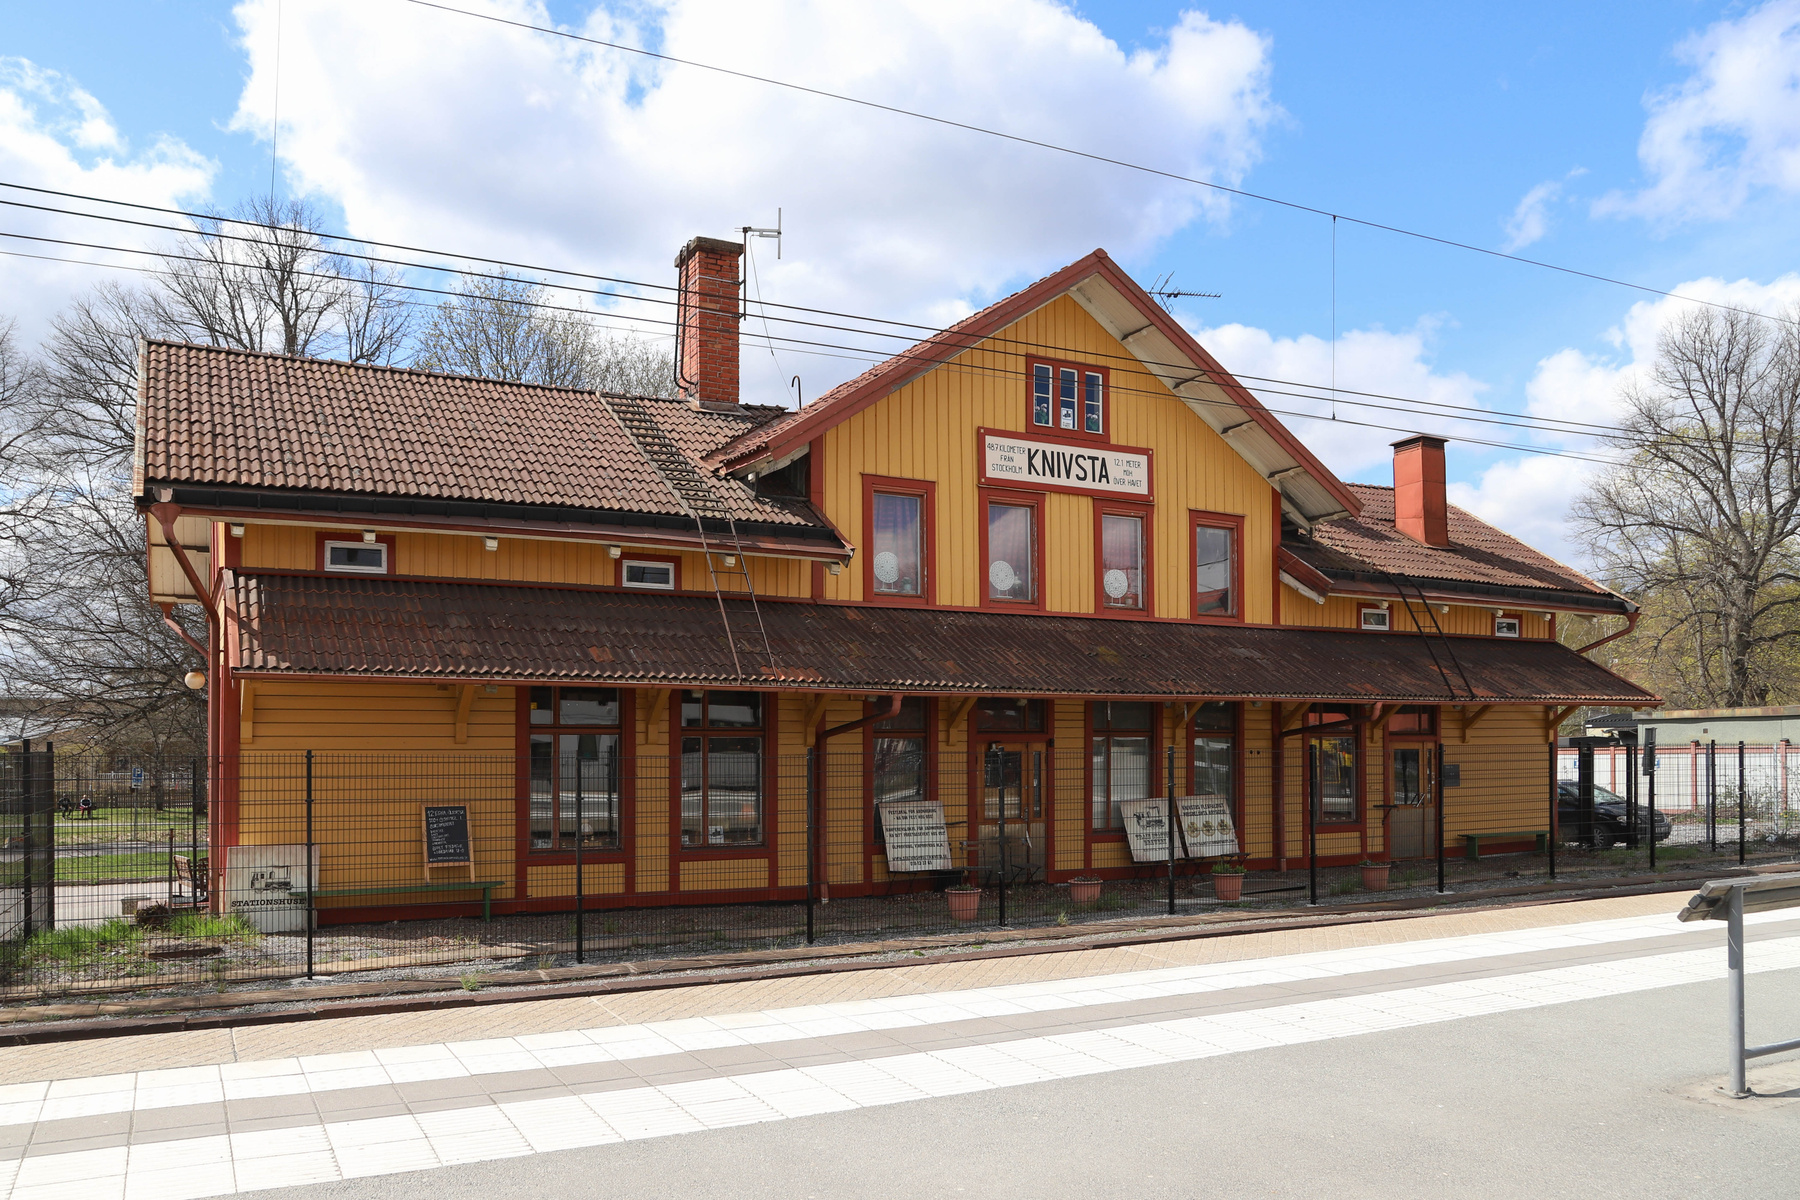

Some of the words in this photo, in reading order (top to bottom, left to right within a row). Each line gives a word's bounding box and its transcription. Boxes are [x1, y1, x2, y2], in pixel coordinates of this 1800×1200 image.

[999, 444, 1026, 455] KILOMETER
[1000, 454, 1014, 462] FRÅN
[992, 464, 1022, 474] STOCKHOLM
[1028, 448, 1110, 484] KNIVSTA
[1126, 460, 1141, 469] METER
[1113, 477, 1126, 486] ÖVER
[1128, 479, 1142, 487] HAVET
[231, 898, 306, 907] STATIONSHUSE
